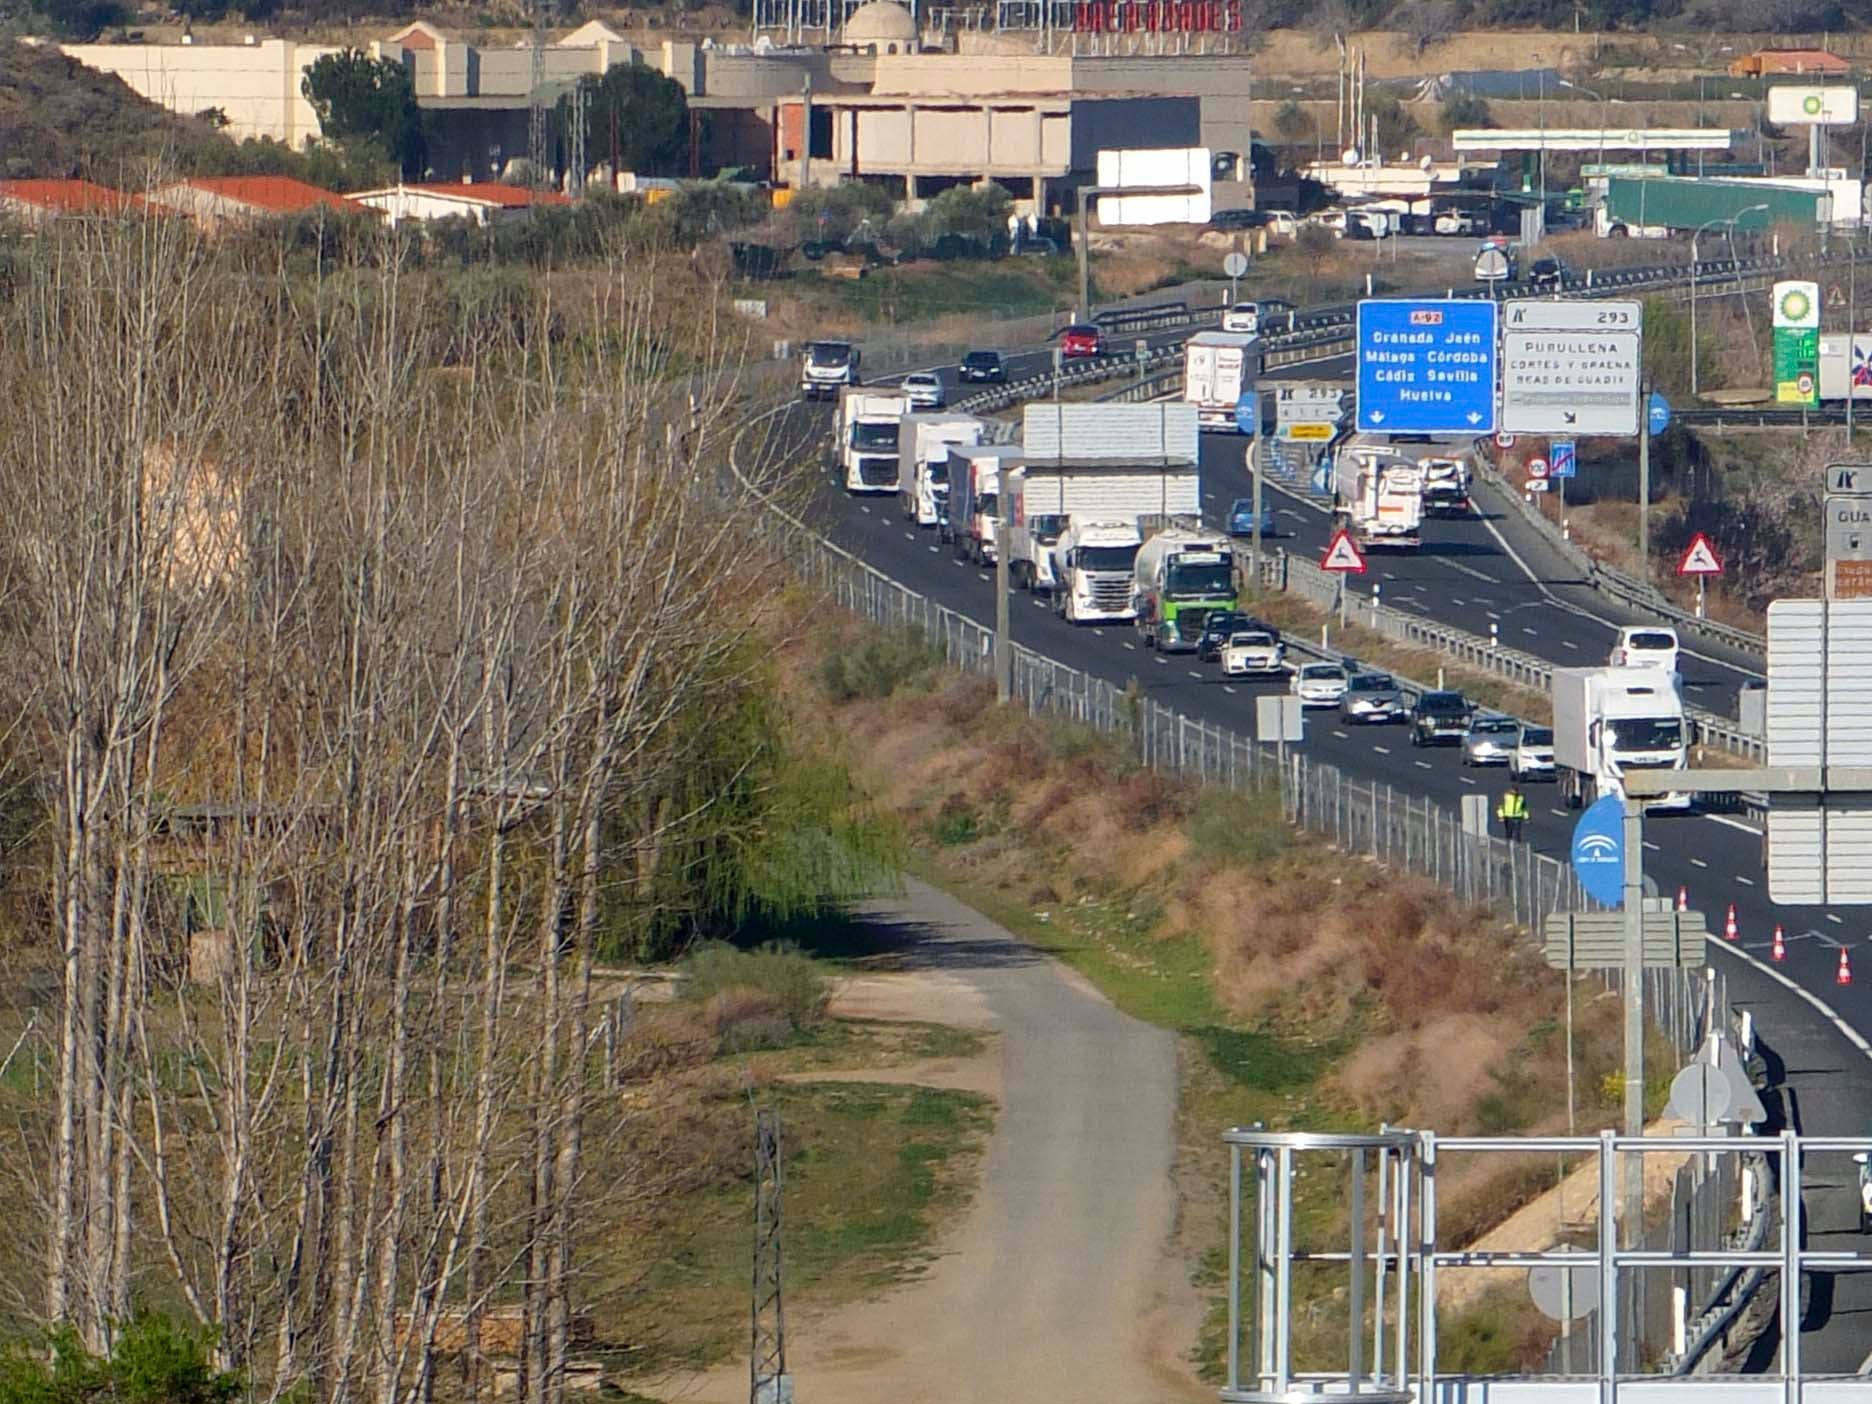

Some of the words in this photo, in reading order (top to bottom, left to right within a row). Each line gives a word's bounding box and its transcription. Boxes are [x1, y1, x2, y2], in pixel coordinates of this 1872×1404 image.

[1597, 311, 1629, 324] 293
[1373, 331, 1434, 344] Granada
[1427, 350, 1488, 364] Córdoba
[1400, 389, 1452, 402] Huelva
